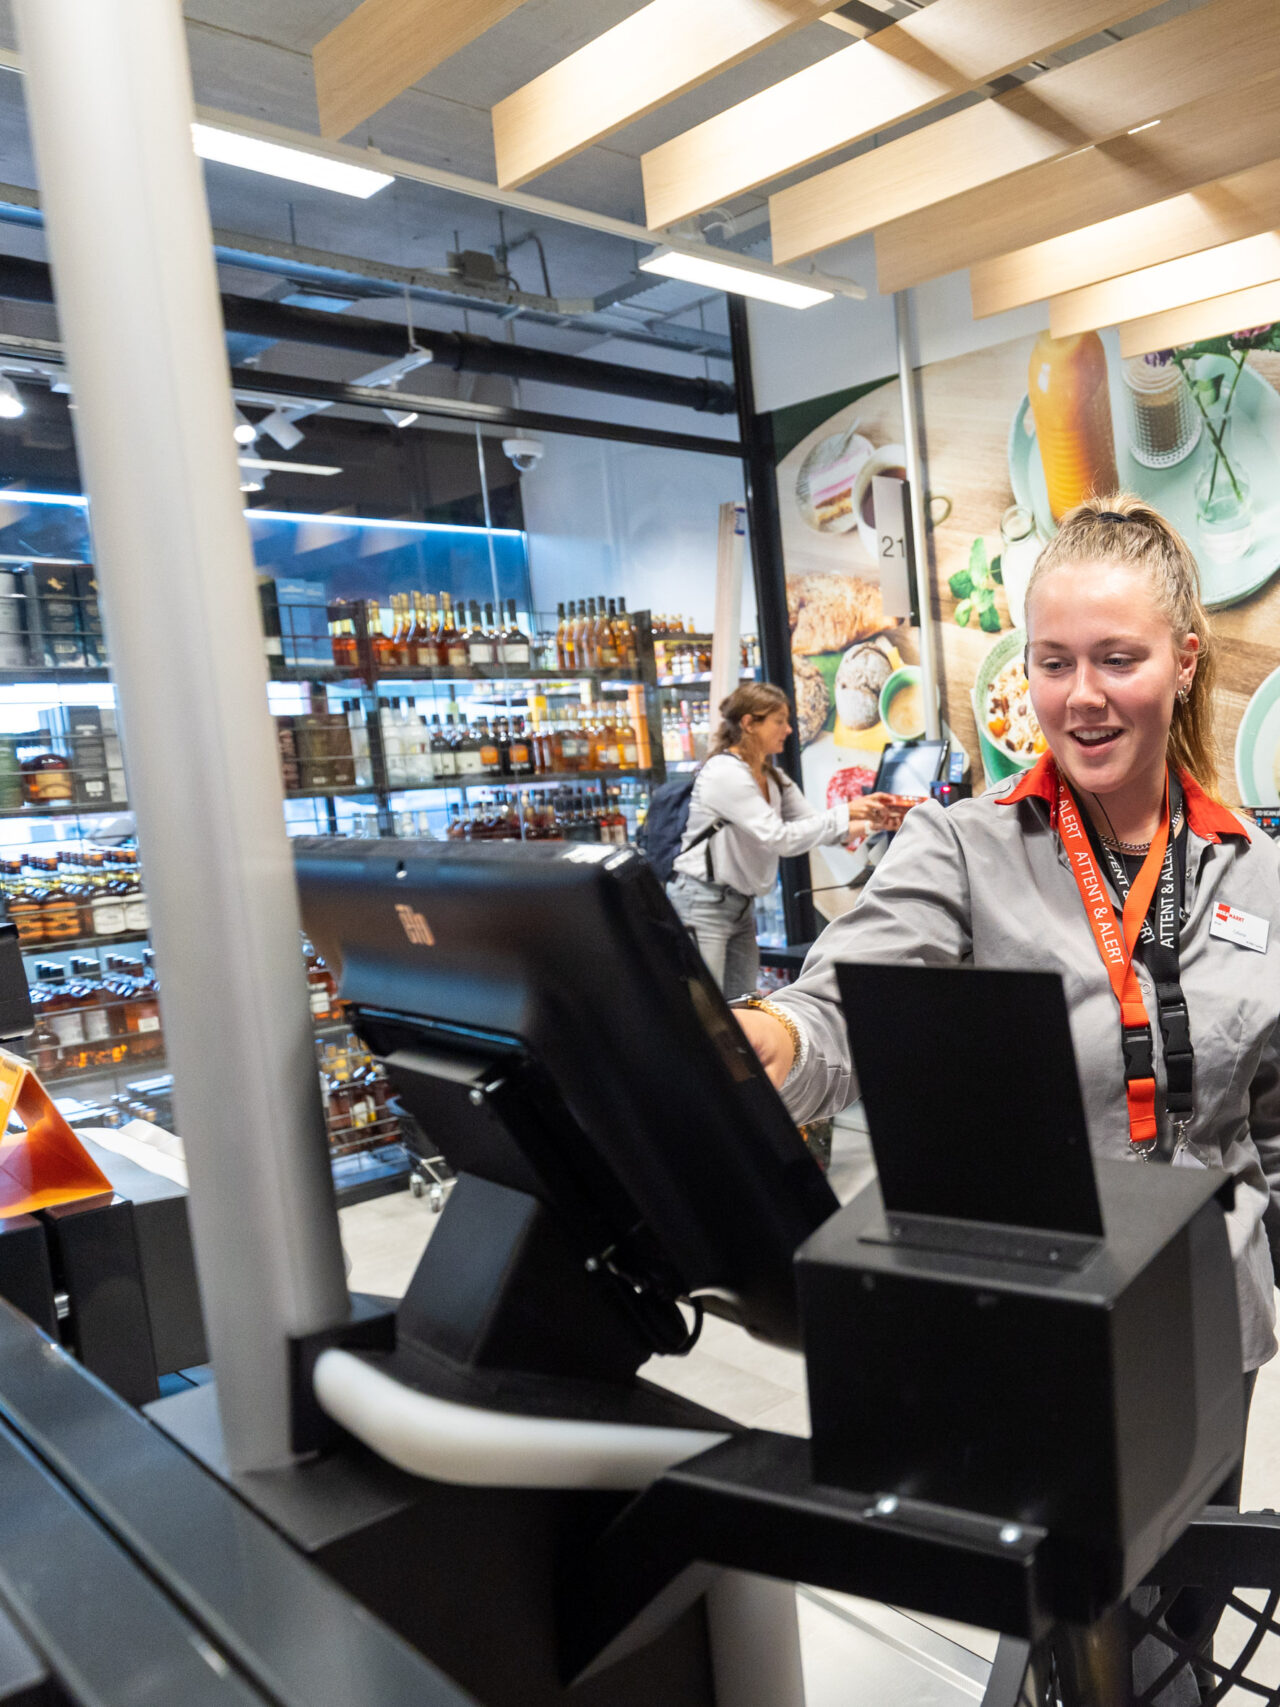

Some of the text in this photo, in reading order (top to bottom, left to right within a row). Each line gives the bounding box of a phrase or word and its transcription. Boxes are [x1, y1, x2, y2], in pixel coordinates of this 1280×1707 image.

[881, 535, 905, 558] 21
[1058, 799, 1083, 839] ALERT
[1074, 851, 1125, 966] ATTENT & ALERT
[1161, 883, 1174, 894] &
[1160, 897, 1175, 948] ATTENT
